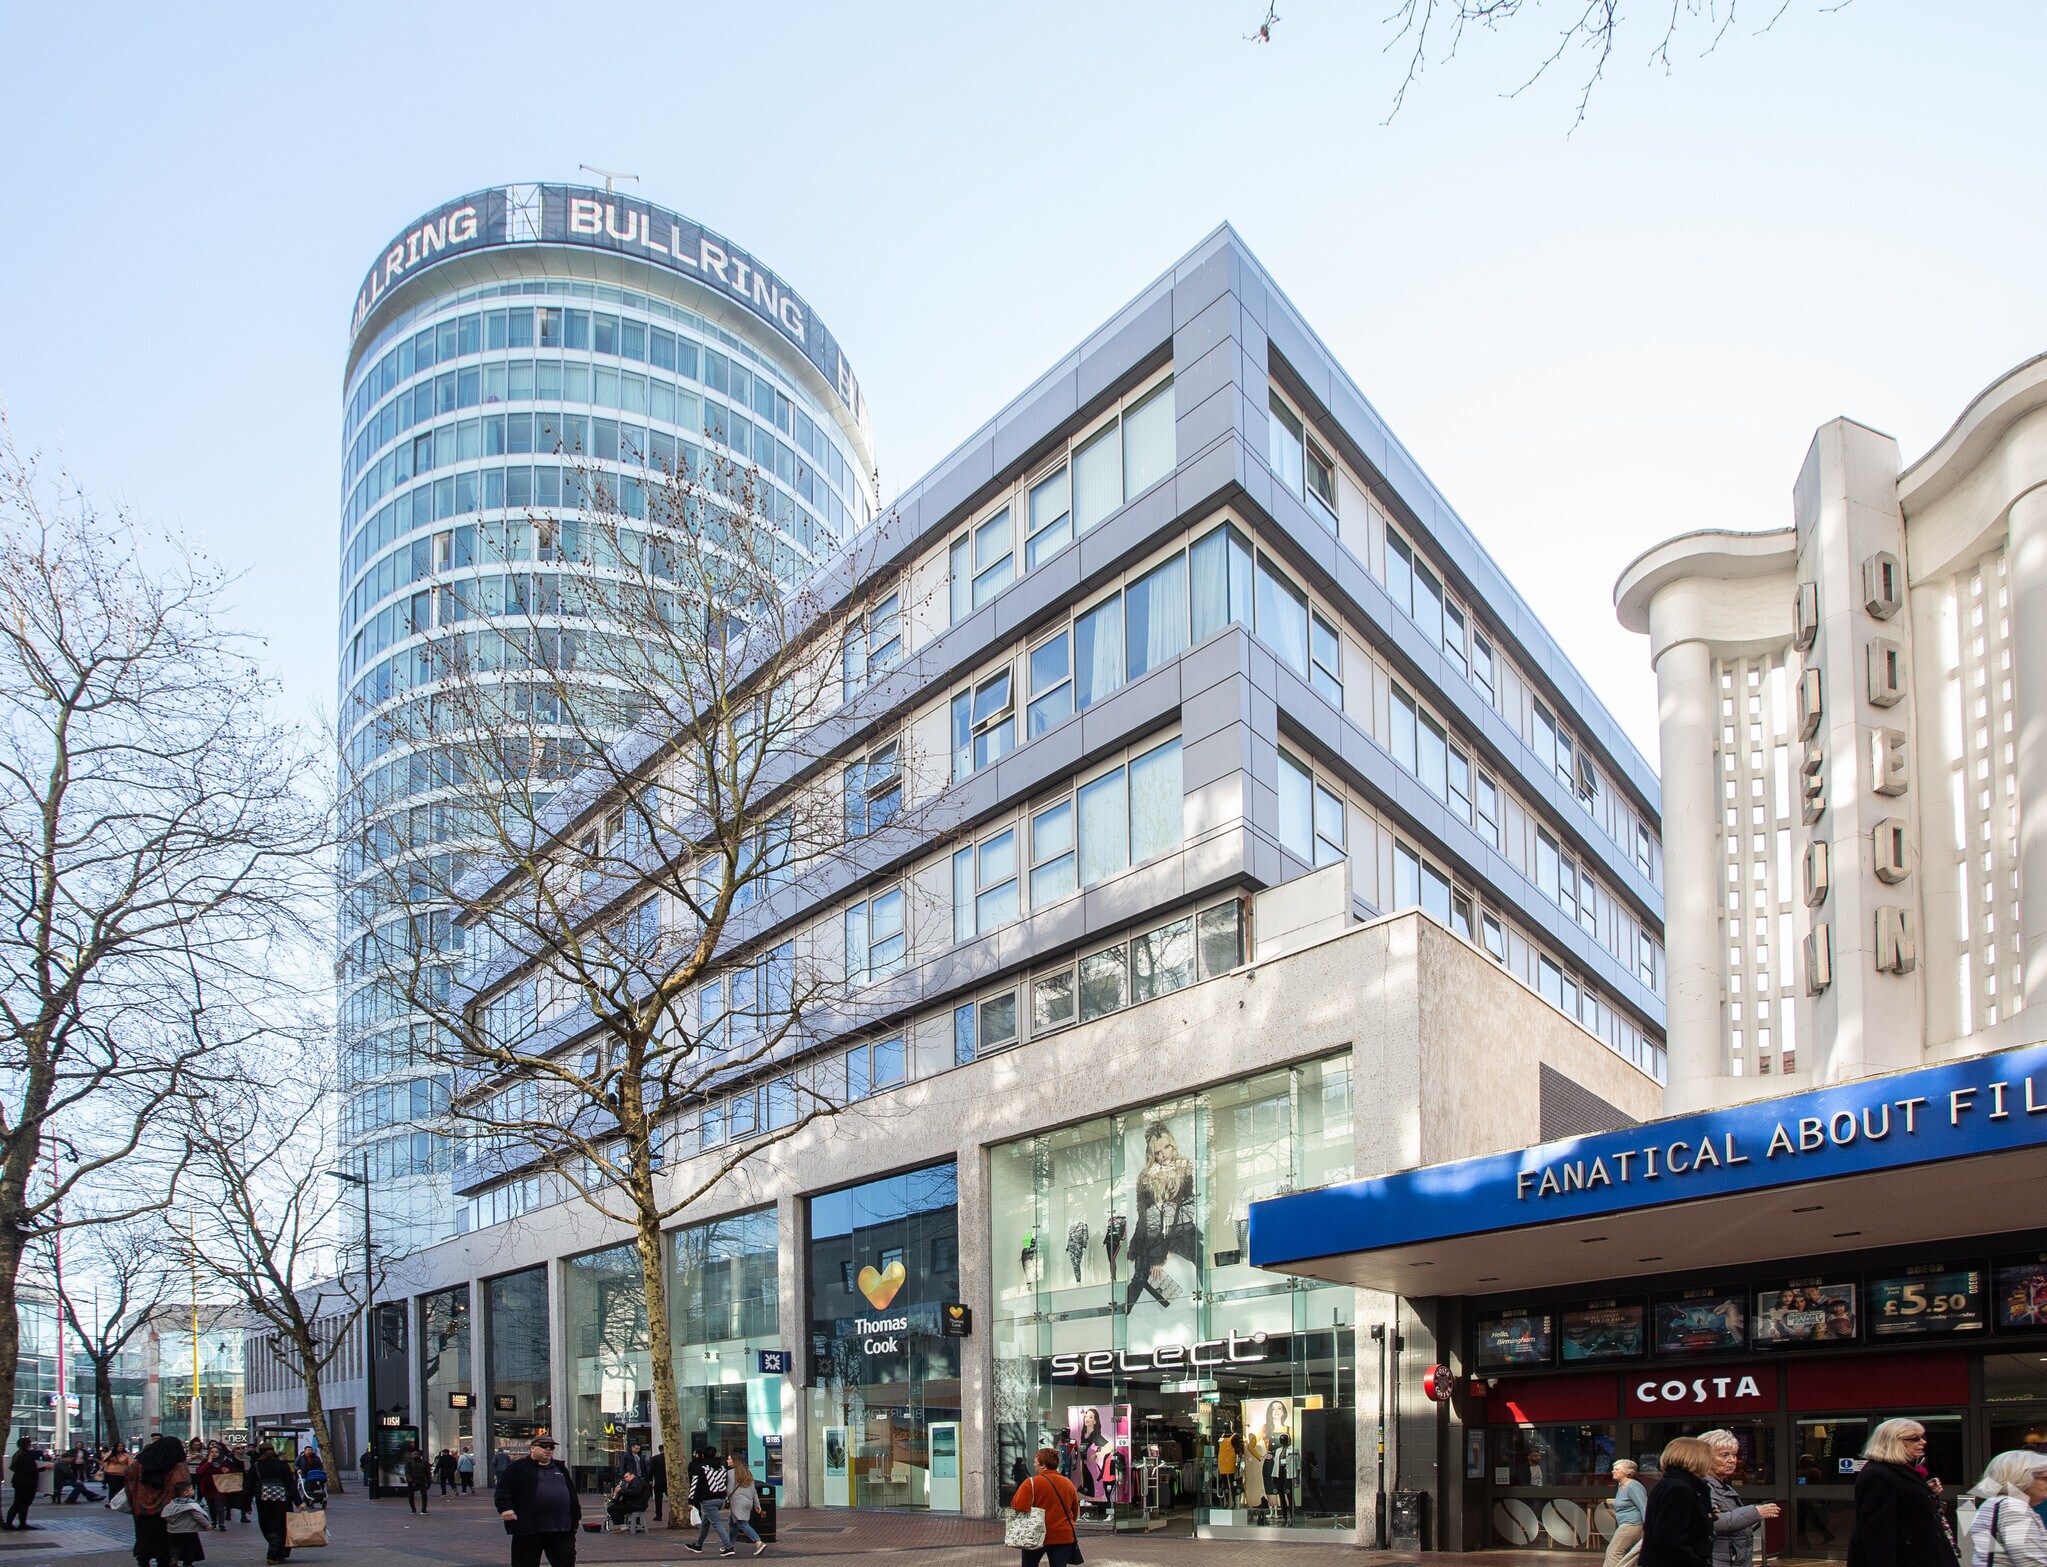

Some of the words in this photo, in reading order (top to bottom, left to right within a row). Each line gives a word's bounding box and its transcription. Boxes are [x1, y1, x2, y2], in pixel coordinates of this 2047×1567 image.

[570, 198, 805, 345] BULLRING
[1793, 581, 1831, 998] ODEON
[1864, 550, 1917, 975] ODEON
[1516, 1132, 1749, 1200] FANATICAL
[1765, 1096, 1925, 1159] ABOUT
[1949, 1076, 2047, 1125] FIL
[855, 1316, 908, 1335] Thomas
[864, 1336, 898, 1355] Cook
[1636, 1375, 1761, 1403] COSTA
